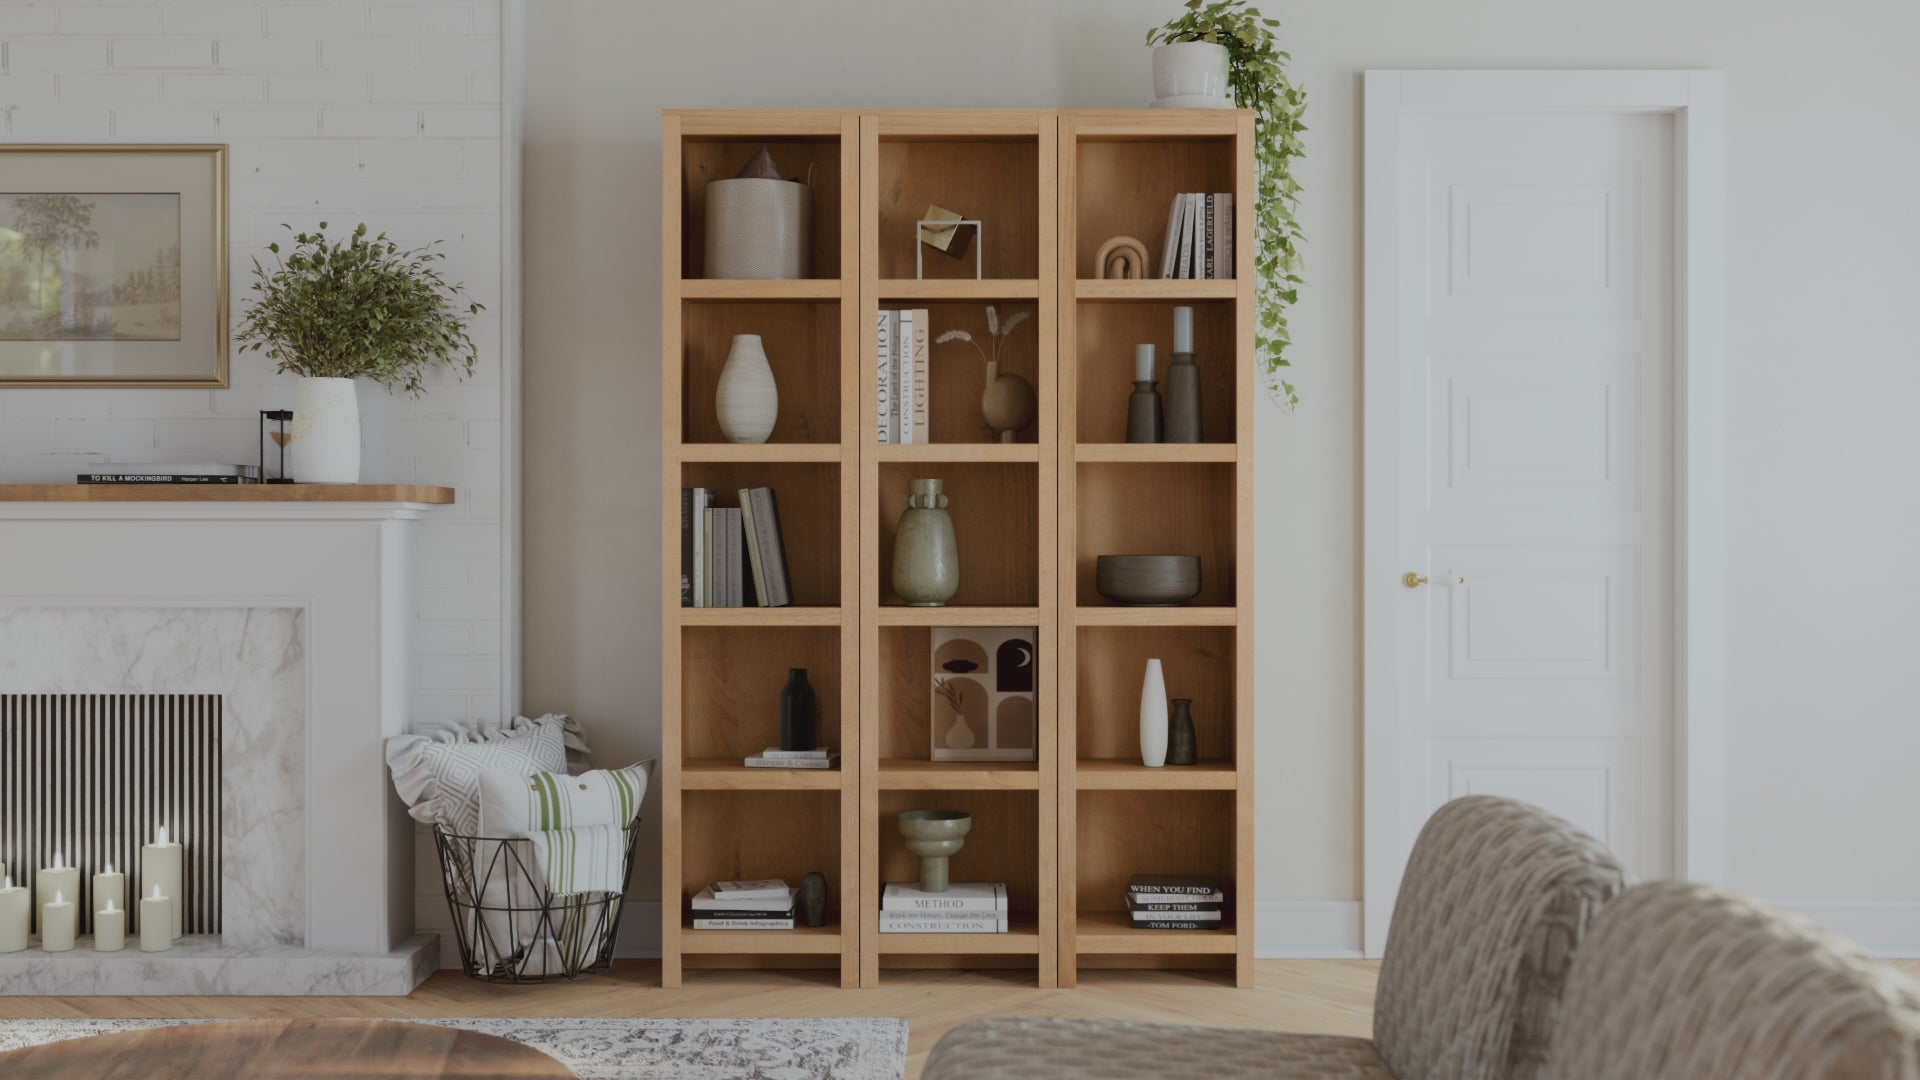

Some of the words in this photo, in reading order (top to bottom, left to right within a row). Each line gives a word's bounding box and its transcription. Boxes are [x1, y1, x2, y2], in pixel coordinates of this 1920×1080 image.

[878, 314, 888, 442] DECORATION
[892, 372, 898, 380] of
[914, 329, 925, 426] LIGHTING
[891, 403, 899, 417] The
[914, 900, 964, 908] METHOD
